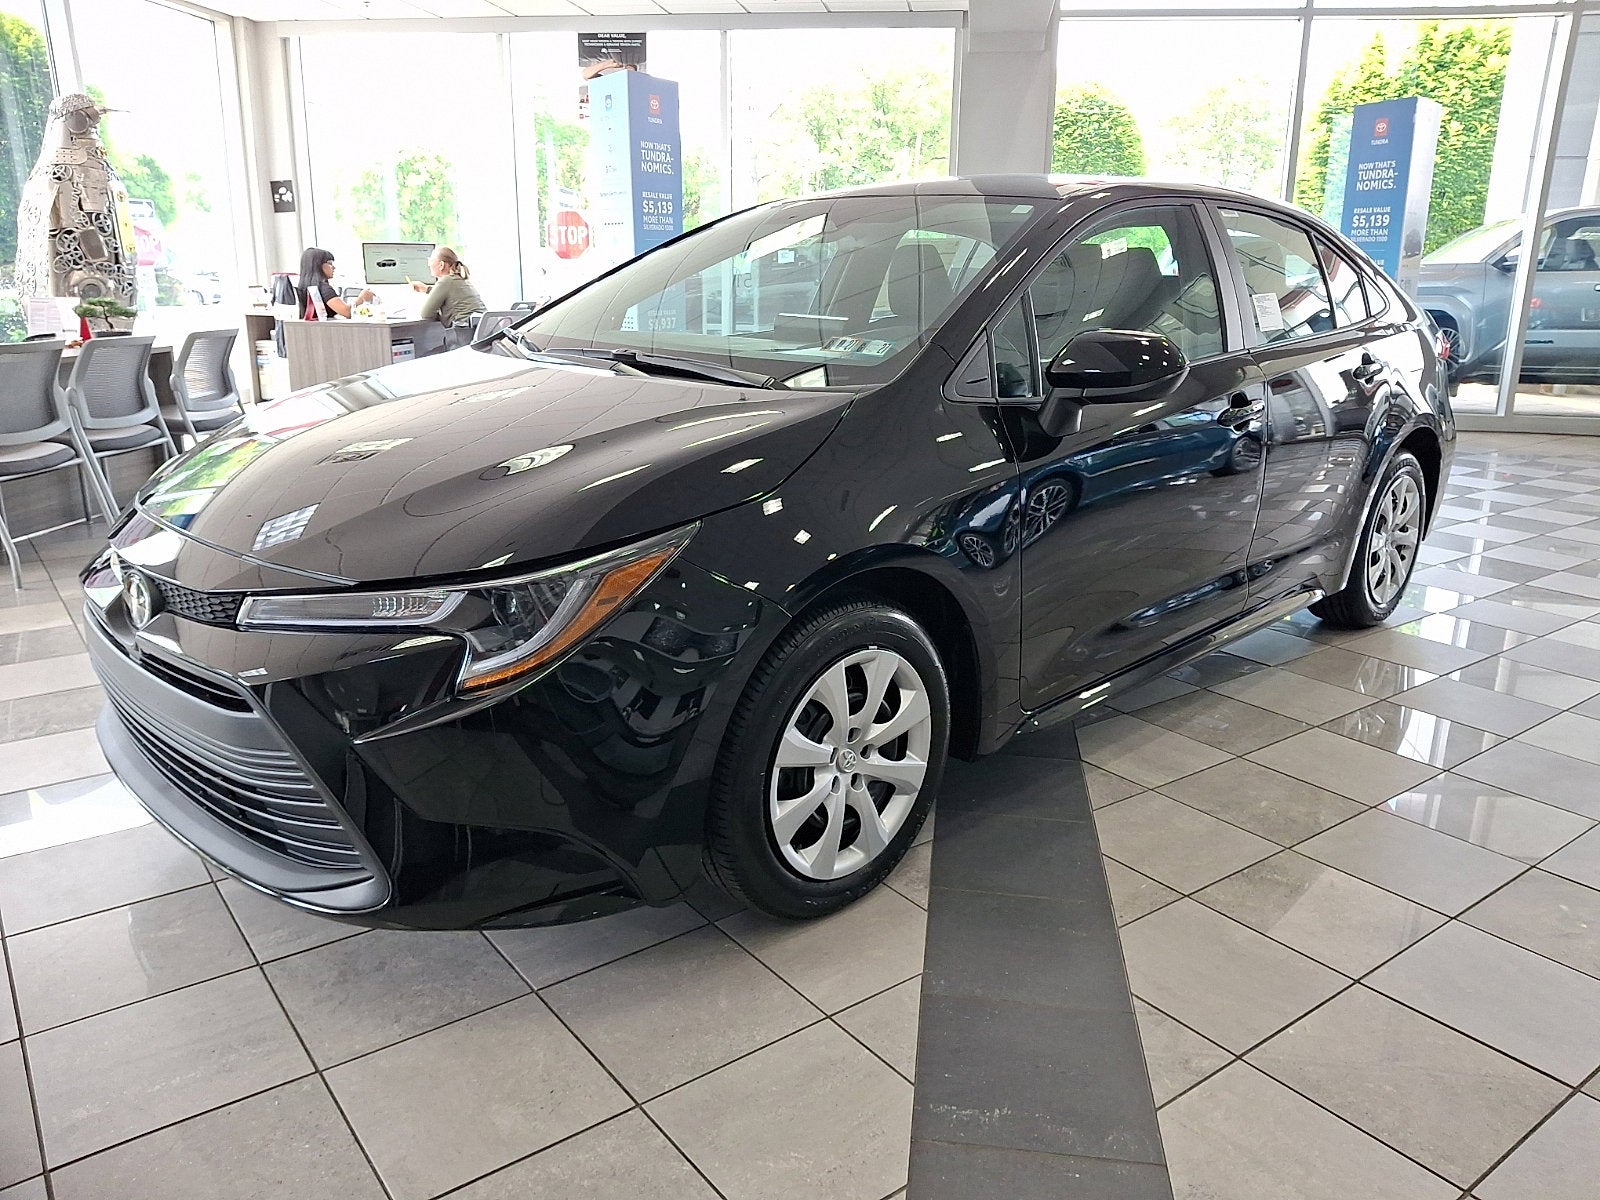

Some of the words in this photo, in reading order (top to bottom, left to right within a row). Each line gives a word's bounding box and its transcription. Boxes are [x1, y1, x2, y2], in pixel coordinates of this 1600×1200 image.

[648, 117, 663, 125] TUNDRA
[640, 140, 654, 150] NOW
[653, 142, 672, 152] THAT'S
[1371, 138, 1388, 146] TUNDRA
[641, 150, 674, 163] TUNDRA-
[641, 161, 674, 175] NOMICS.
[1374, 160, 1396, 169] THAT'S
[1358, 169, 1398, 181] TUNDRA-
[1356, 180, 1397, 191] NOMICS.
[642, 191, 659, 199] RESALE
[659, 192, 673, 200] VALUE
[642, 200, 673, 215] $5,139
[643, 215, 659, 224] MORE
[659, 216, 674, 225] THAN
[1352, 214, 1390, 228] $5,139
[550, 225, 588, 245] STOP
[1370, 228, 1388, 236] THAN
